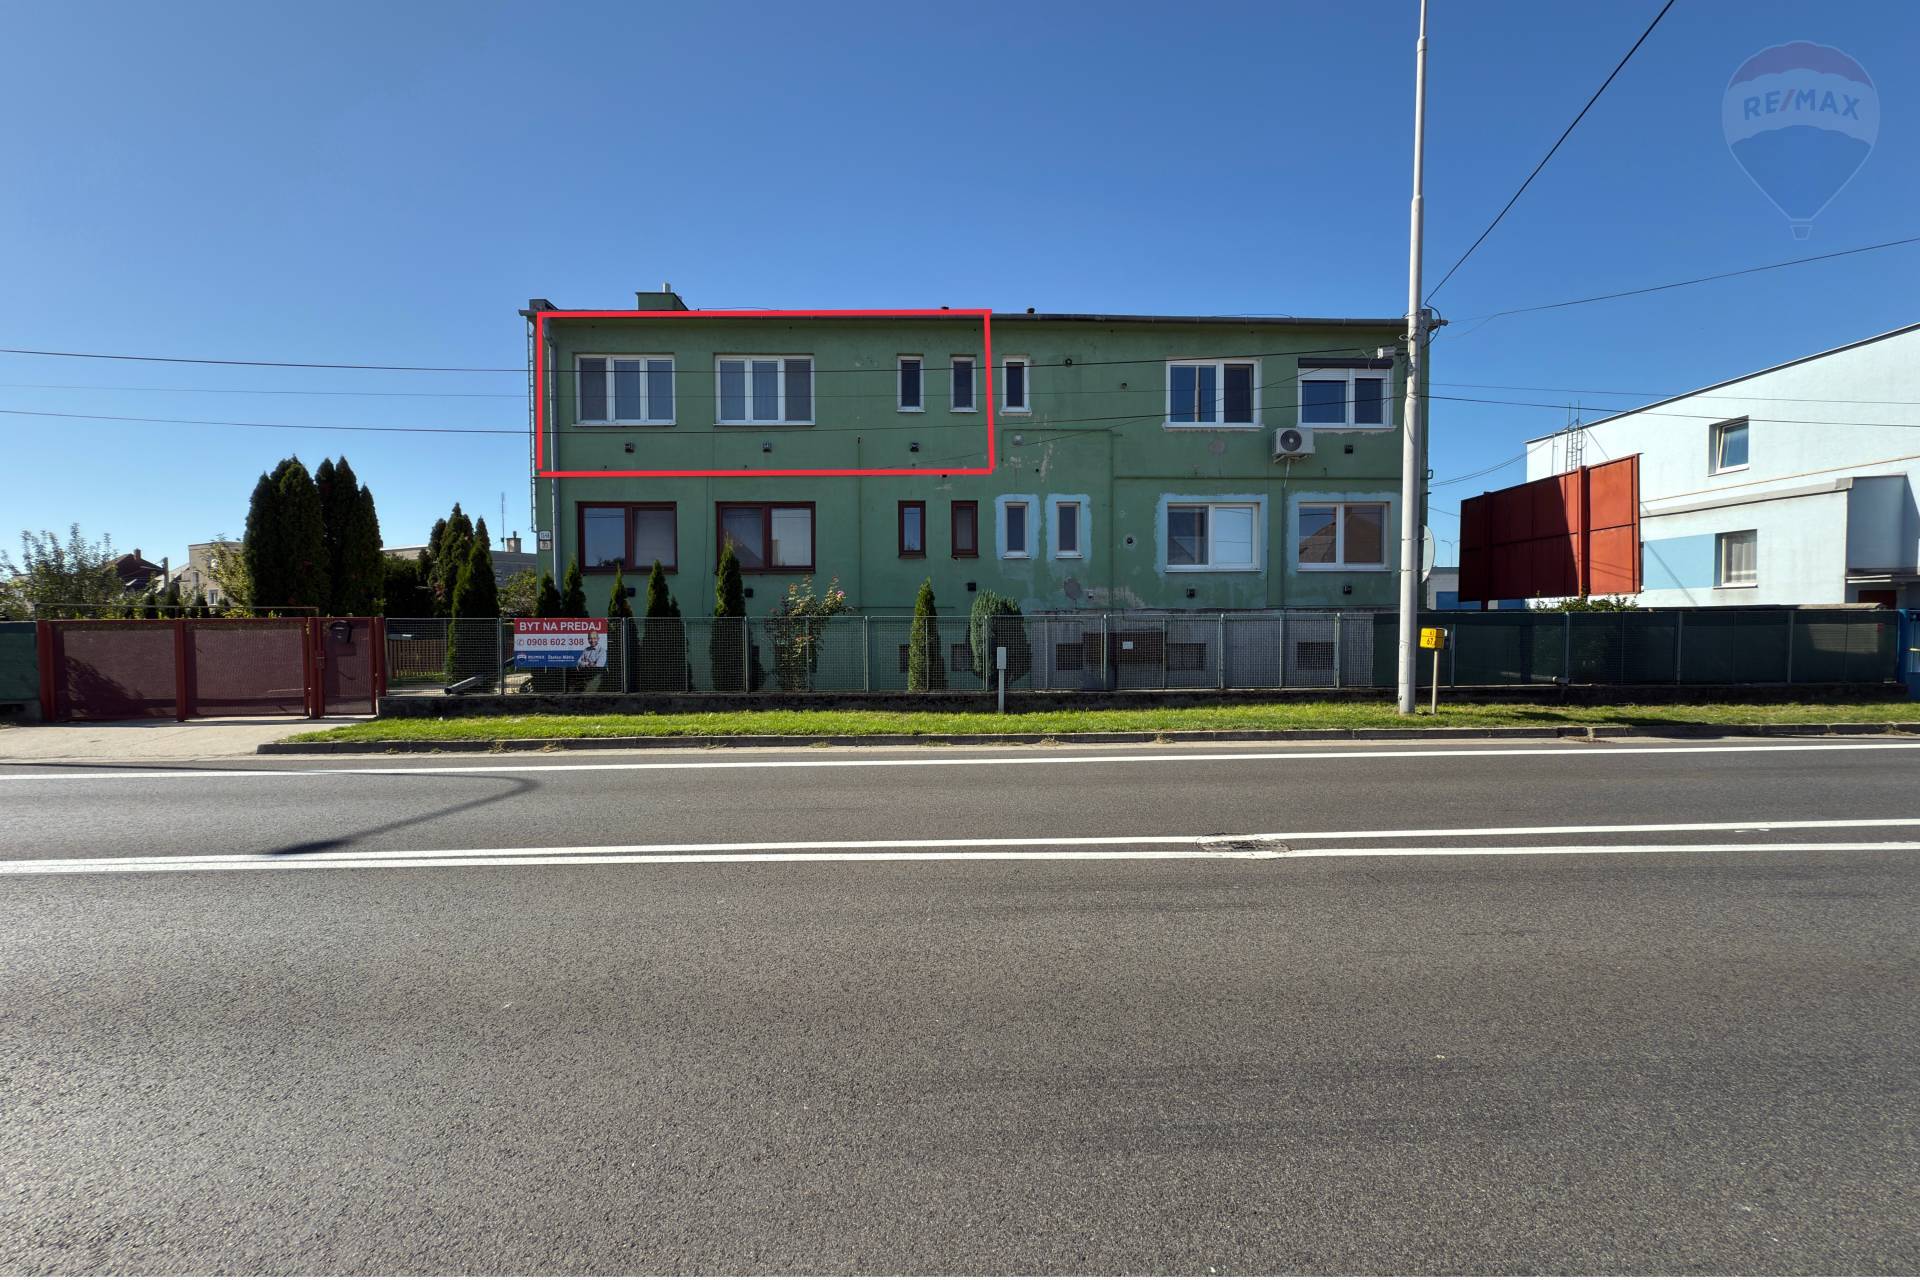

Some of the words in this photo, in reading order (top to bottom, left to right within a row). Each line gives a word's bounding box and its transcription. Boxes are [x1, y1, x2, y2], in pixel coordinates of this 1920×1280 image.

[519, 622, 541, 631] BYT
[543, 622, 558, 631] NA
[560, 622, 602, 631] PREDAJ
[526, 638, 548, 646] 0908
[550, 638, 566, 646] 602
[568, 638, 584, 646] 308
